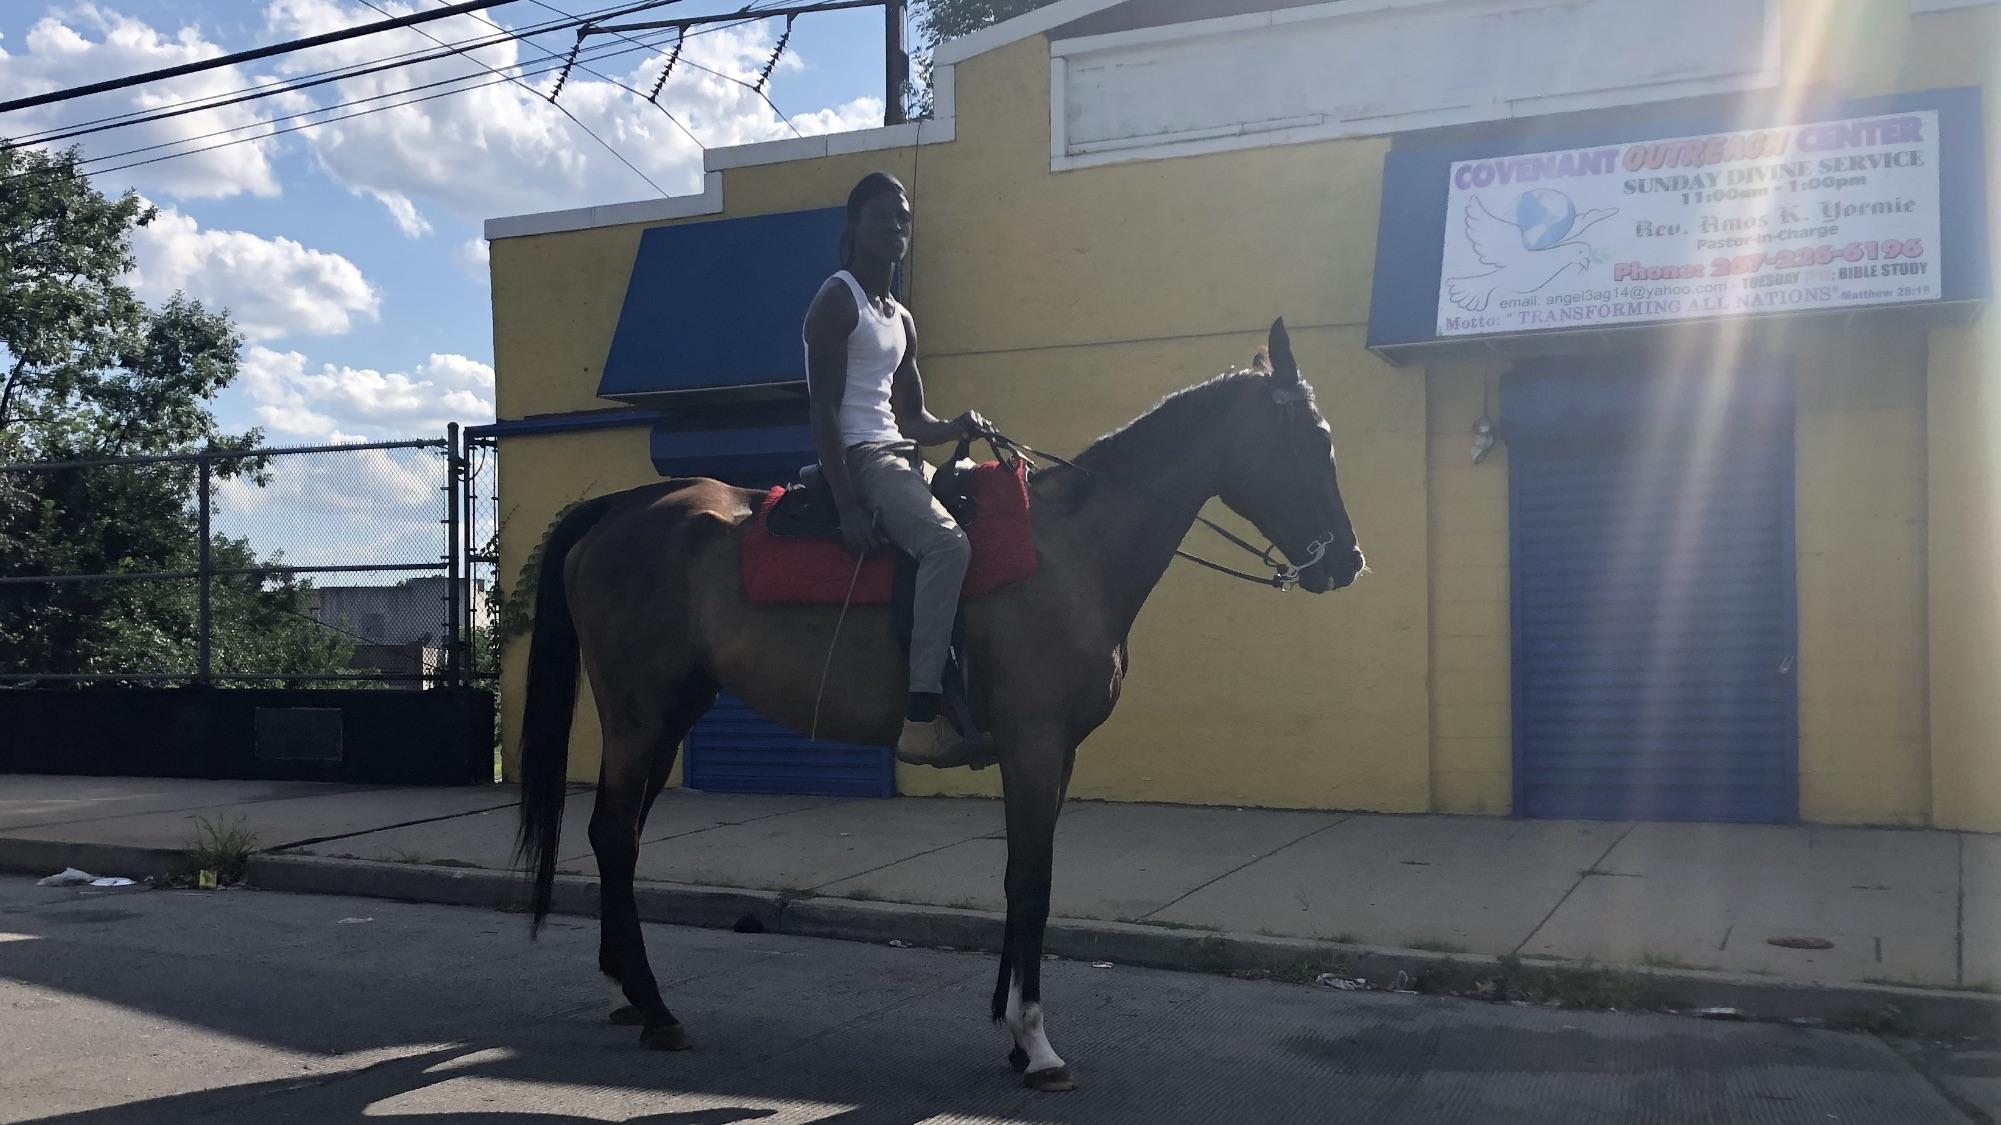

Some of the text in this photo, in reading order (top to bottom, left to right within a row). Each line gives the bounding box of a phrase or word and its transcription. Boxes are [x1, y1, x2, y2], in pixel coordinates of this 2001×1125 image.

[1454, 116, 1924, 190] COVENANT OUTREACH CENTER
[1623, 149, 1925, 195] SUNDAY DIVINE SERVICE
[1681, 187, 1769, 205] 11:00am
[1789, 175, 1867, 193] 1:00pm
[1635, 197, 1916, 238] Rev. Amos K. Yormie
[1613, 260, 1706, 283] Phone:
[1710, 238, 1924, 278] 267-226-6196
[1742, 271, 1800, 289] TUESDAY
[1838, 264, 1879, 280] BIBLE
[1881, 261, 1928, 277] STUDY
[1445, 317, 1501, 331] Motto:
[1517, 299, 1682, 326] TRANSFORMING
[1688, 296, 1730, 311] ALL
